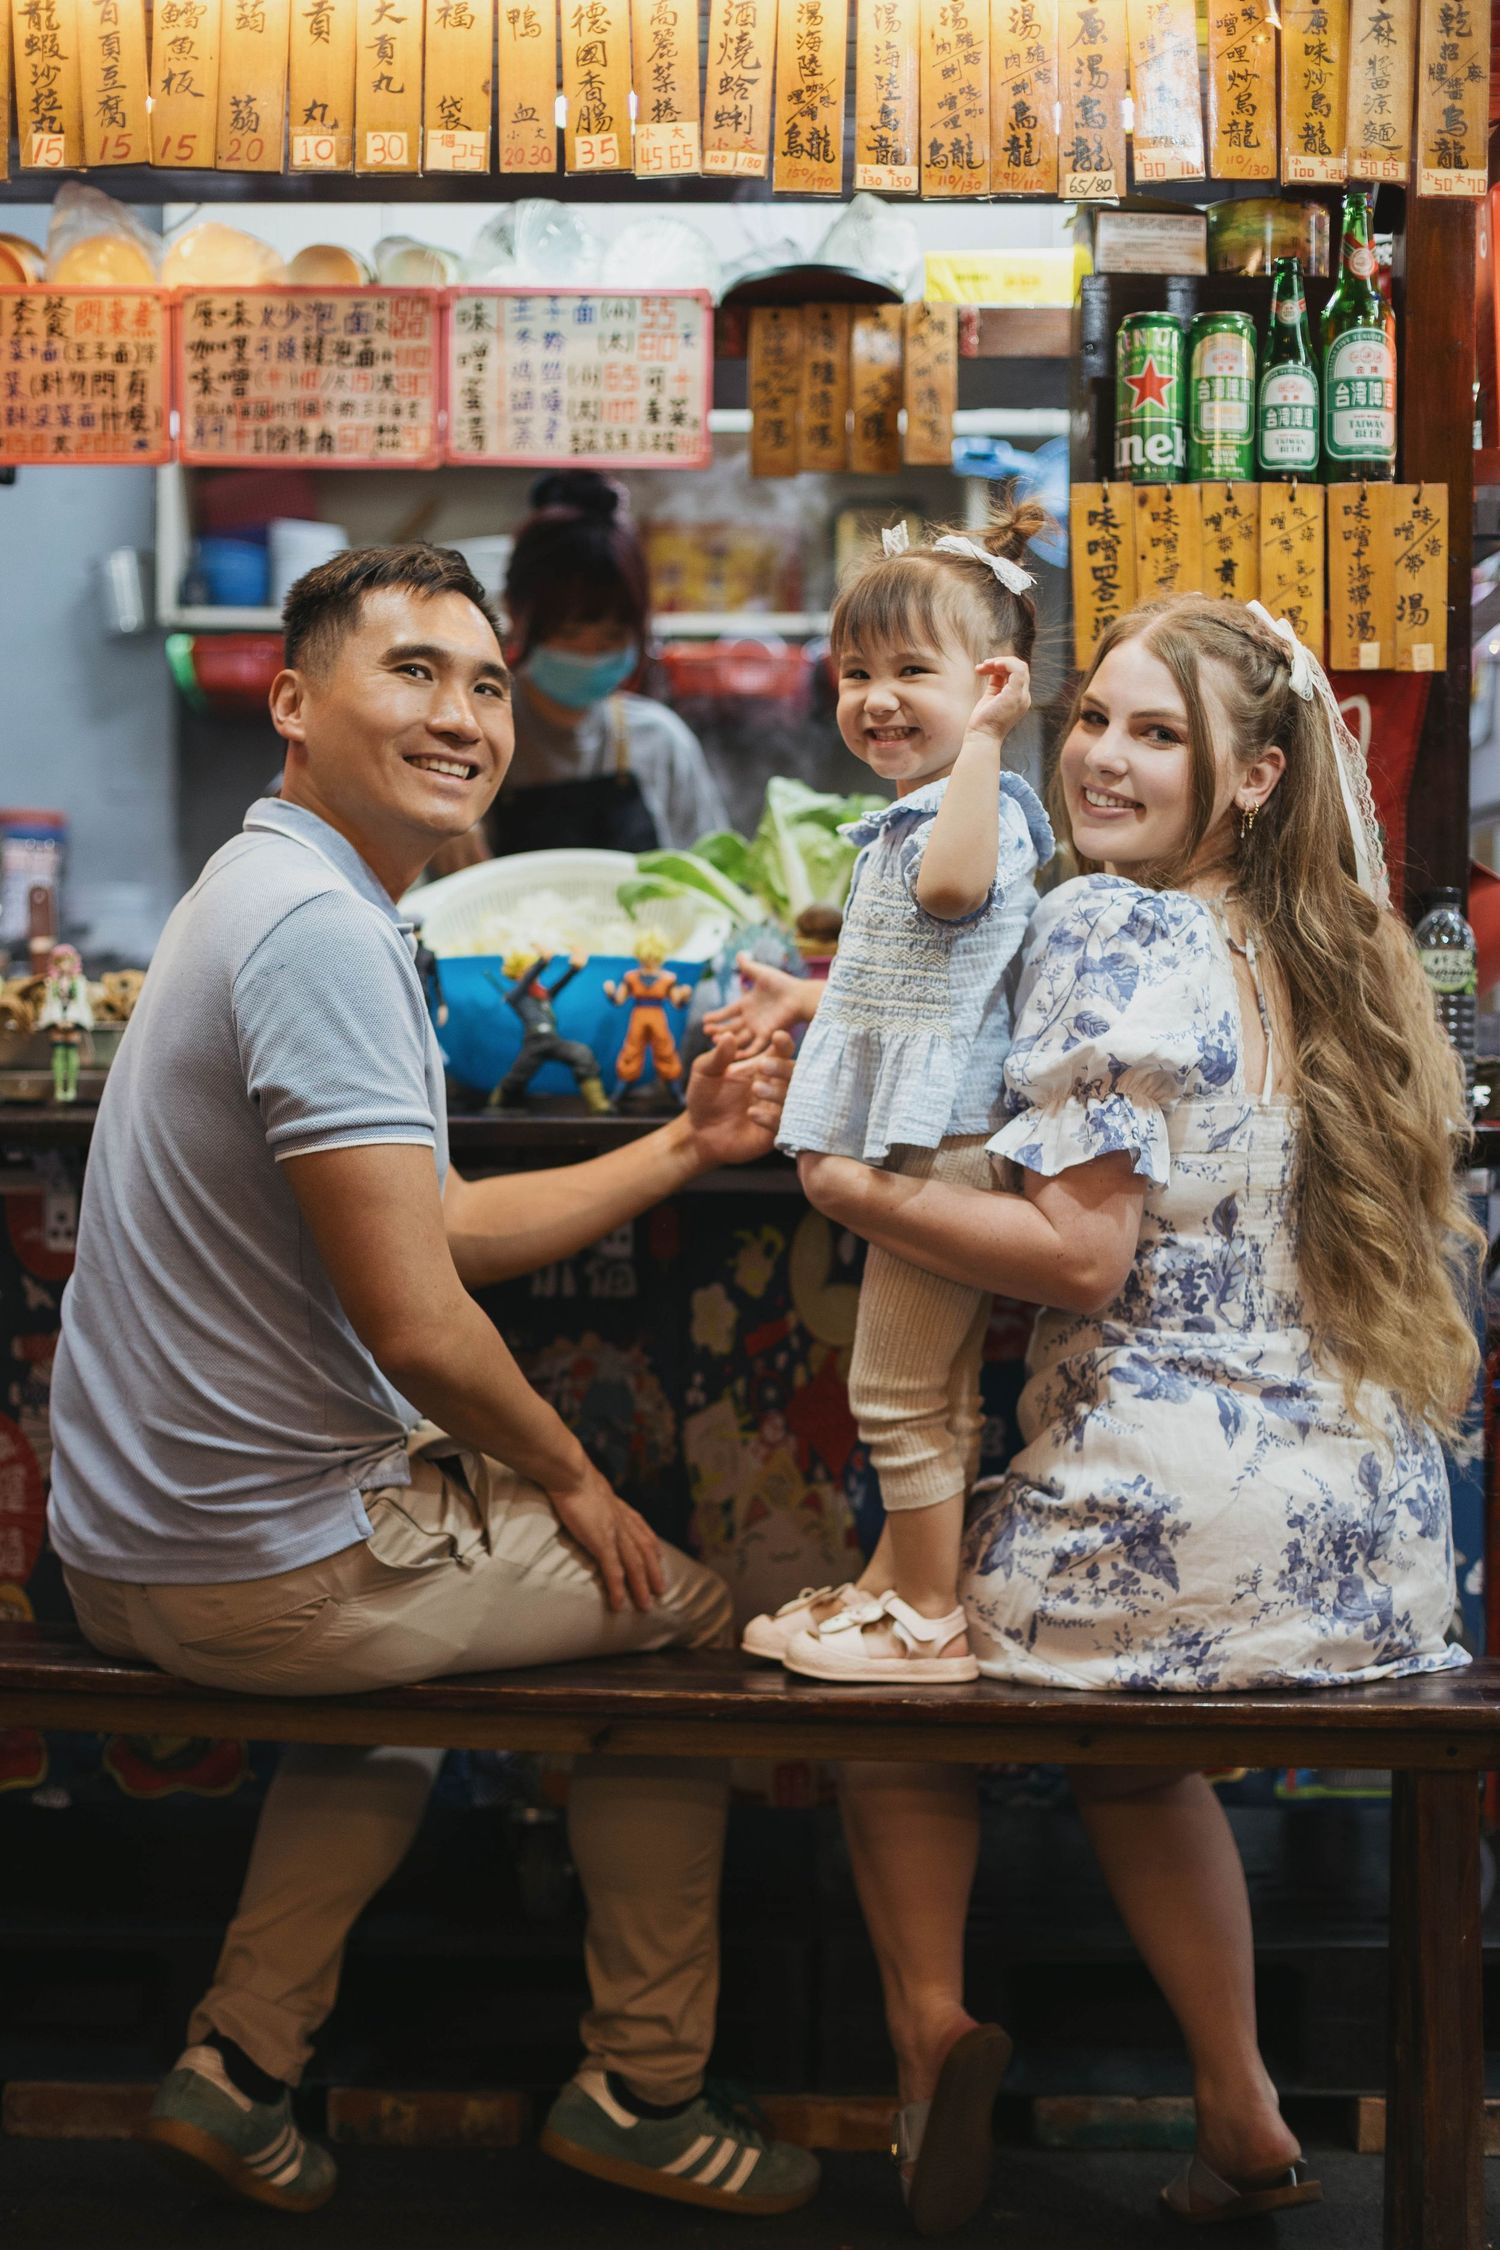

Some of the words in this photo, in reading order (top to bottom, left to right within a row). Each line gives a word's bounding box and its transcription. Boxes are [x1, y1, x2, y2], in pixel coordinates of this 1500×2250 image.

[365, 1, 409, 94] 大貢丸
[434, 1, 475, 131] 福袋
[506, 4, 542, 124] 鴨血
[570, 2, 614, 134] 德國香腸
[640, 130, 655, 139] 小
[671, 126, 686, 139] 大
[33, 137, 64, 165] 15
[99, 134, 132, 160] 15
[160, 135, 198, 159] 15
[226, 139, 265, 162] 20
[301, 139, 335, 159] 10
[371, 134, 405, 165] 30
[581, 137, 618, 165] 35
[711, 138, 729, 150] 小
[740, 137, 757, 151] 大
[452, 143, 485, 169] 25
[503, 147, 525, 165] 20
[527, 145, 552, 165] 30
[640, 144, 663, 171] 45
[669, 143, 693, 169] 65
[709, 153, 728, 165] 100
[740, 153, 762, 169] 180
[1135, 151, 1148, 162] 小
[1291, 158, 1302, 166] 小
[1319, 158, 1328, 167] 大
[1360, 151, 1372, 160] 小
[1385, 151, 1398, 162] 大
[886, 168, 896, 176] 大
[1144, 162, 1166, 177] 80
[1226, 156, 1270, 176] 110/130
[1294, 169, 1315, 178] 100
[1360, 162, 1378, 176] 50
[1382, 162, 1399, 177] 65
[862, 176, 882, 186] 130
[890, 176, 912, 187] 150
[938, 174, 983, 192] 110/130
[1069, 178, 1113, 196] 65/80
[1423, 173, 1434, 181] 小
[1434, 177, 1453, 192] 50
[1454, 173, 1465, 184] 大
[1350, 419, 1386, 429] TAIWAN
[1355, 430, 1382, 439] BEER
